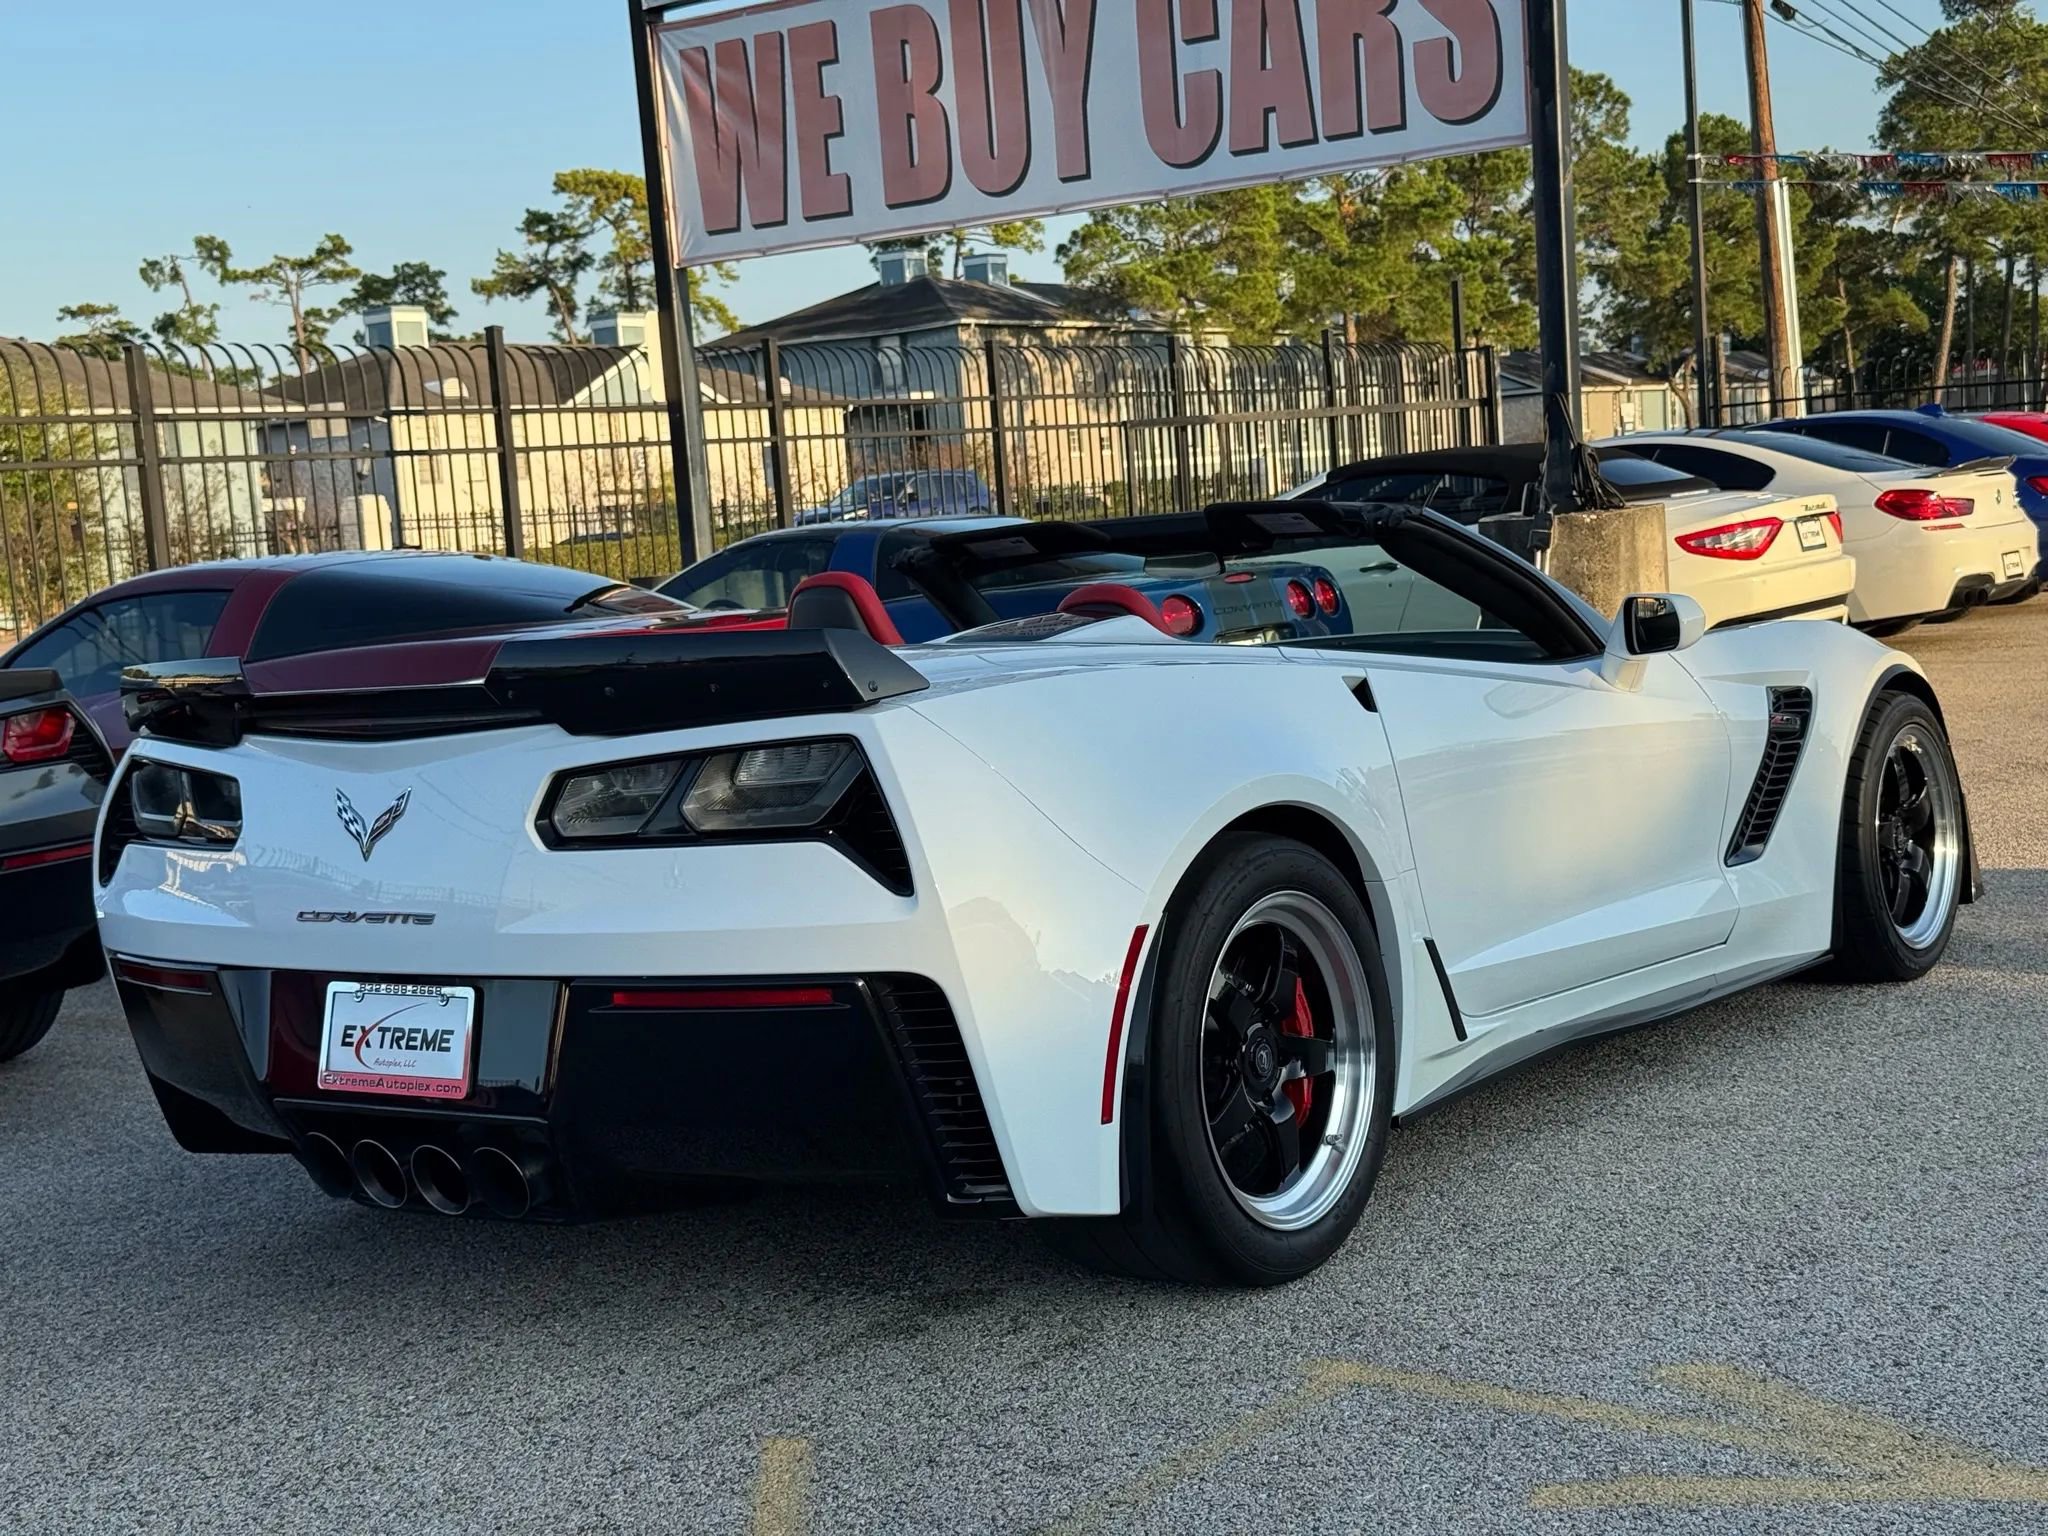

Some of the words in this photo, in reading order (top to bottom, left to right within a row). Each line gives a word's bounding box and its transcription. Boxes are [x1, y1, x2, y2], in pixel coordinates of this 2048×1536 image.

[680, 20, 853, 236] WE
[870, 0, 1096, 209] BUY
[1136, 0, 1503, 169] CARS
[297, 911, 436, 925] CORVETTE
[341, 1025, 455, 1052] EXTREME
[325, 1074, 462, 1094] ExtremeAutoplex.com
